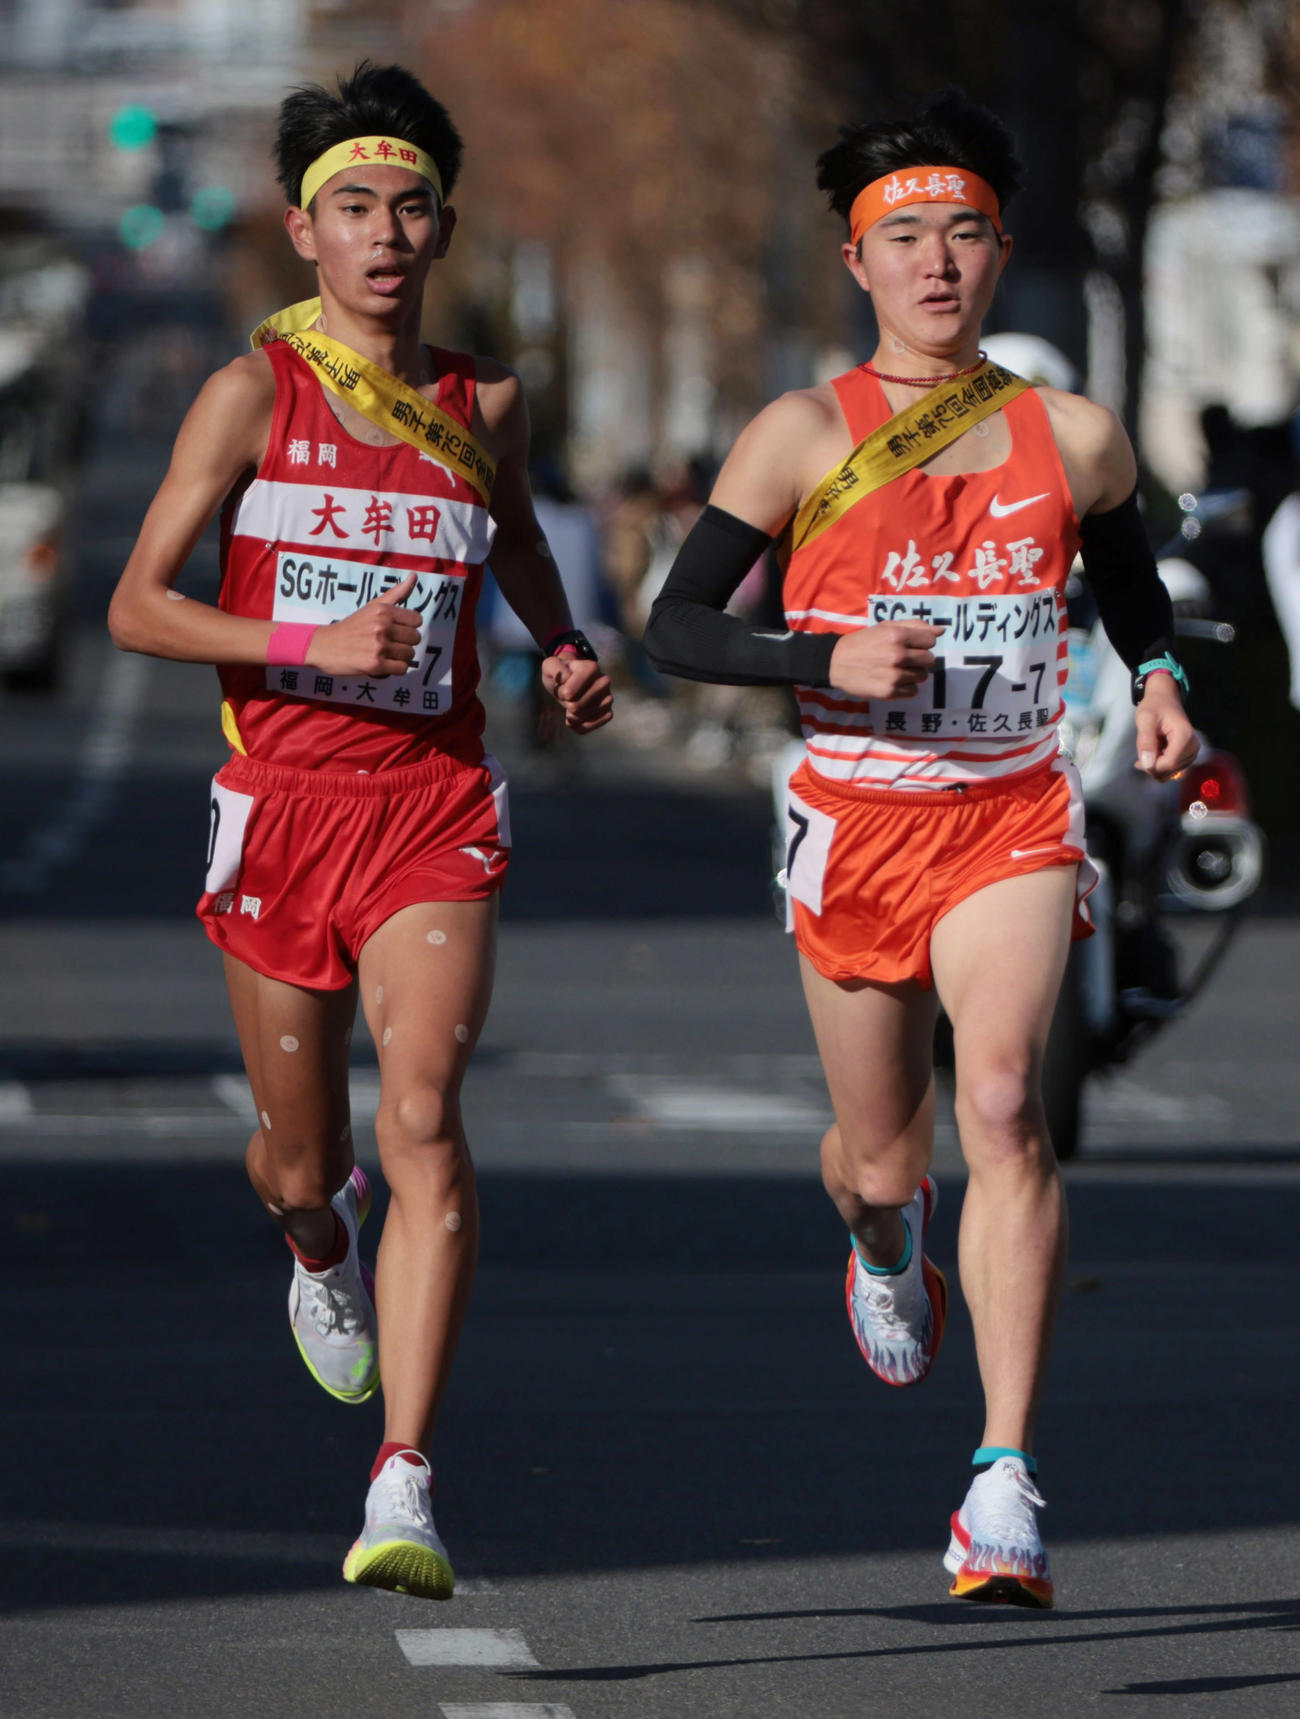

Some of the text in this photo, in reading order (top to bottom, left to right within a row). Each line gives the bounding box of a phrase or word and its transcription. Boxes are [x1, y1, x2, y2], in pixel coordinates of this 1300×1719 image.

[348, 140, 417, 165] 大牟田
[883, 173, 966, 205] 佐久長聖
[287, 438, 338, 469] 福岡
[308, 493, 441, 546] 大牟田
[881, 537, 1044, 592] 佐久長聖
